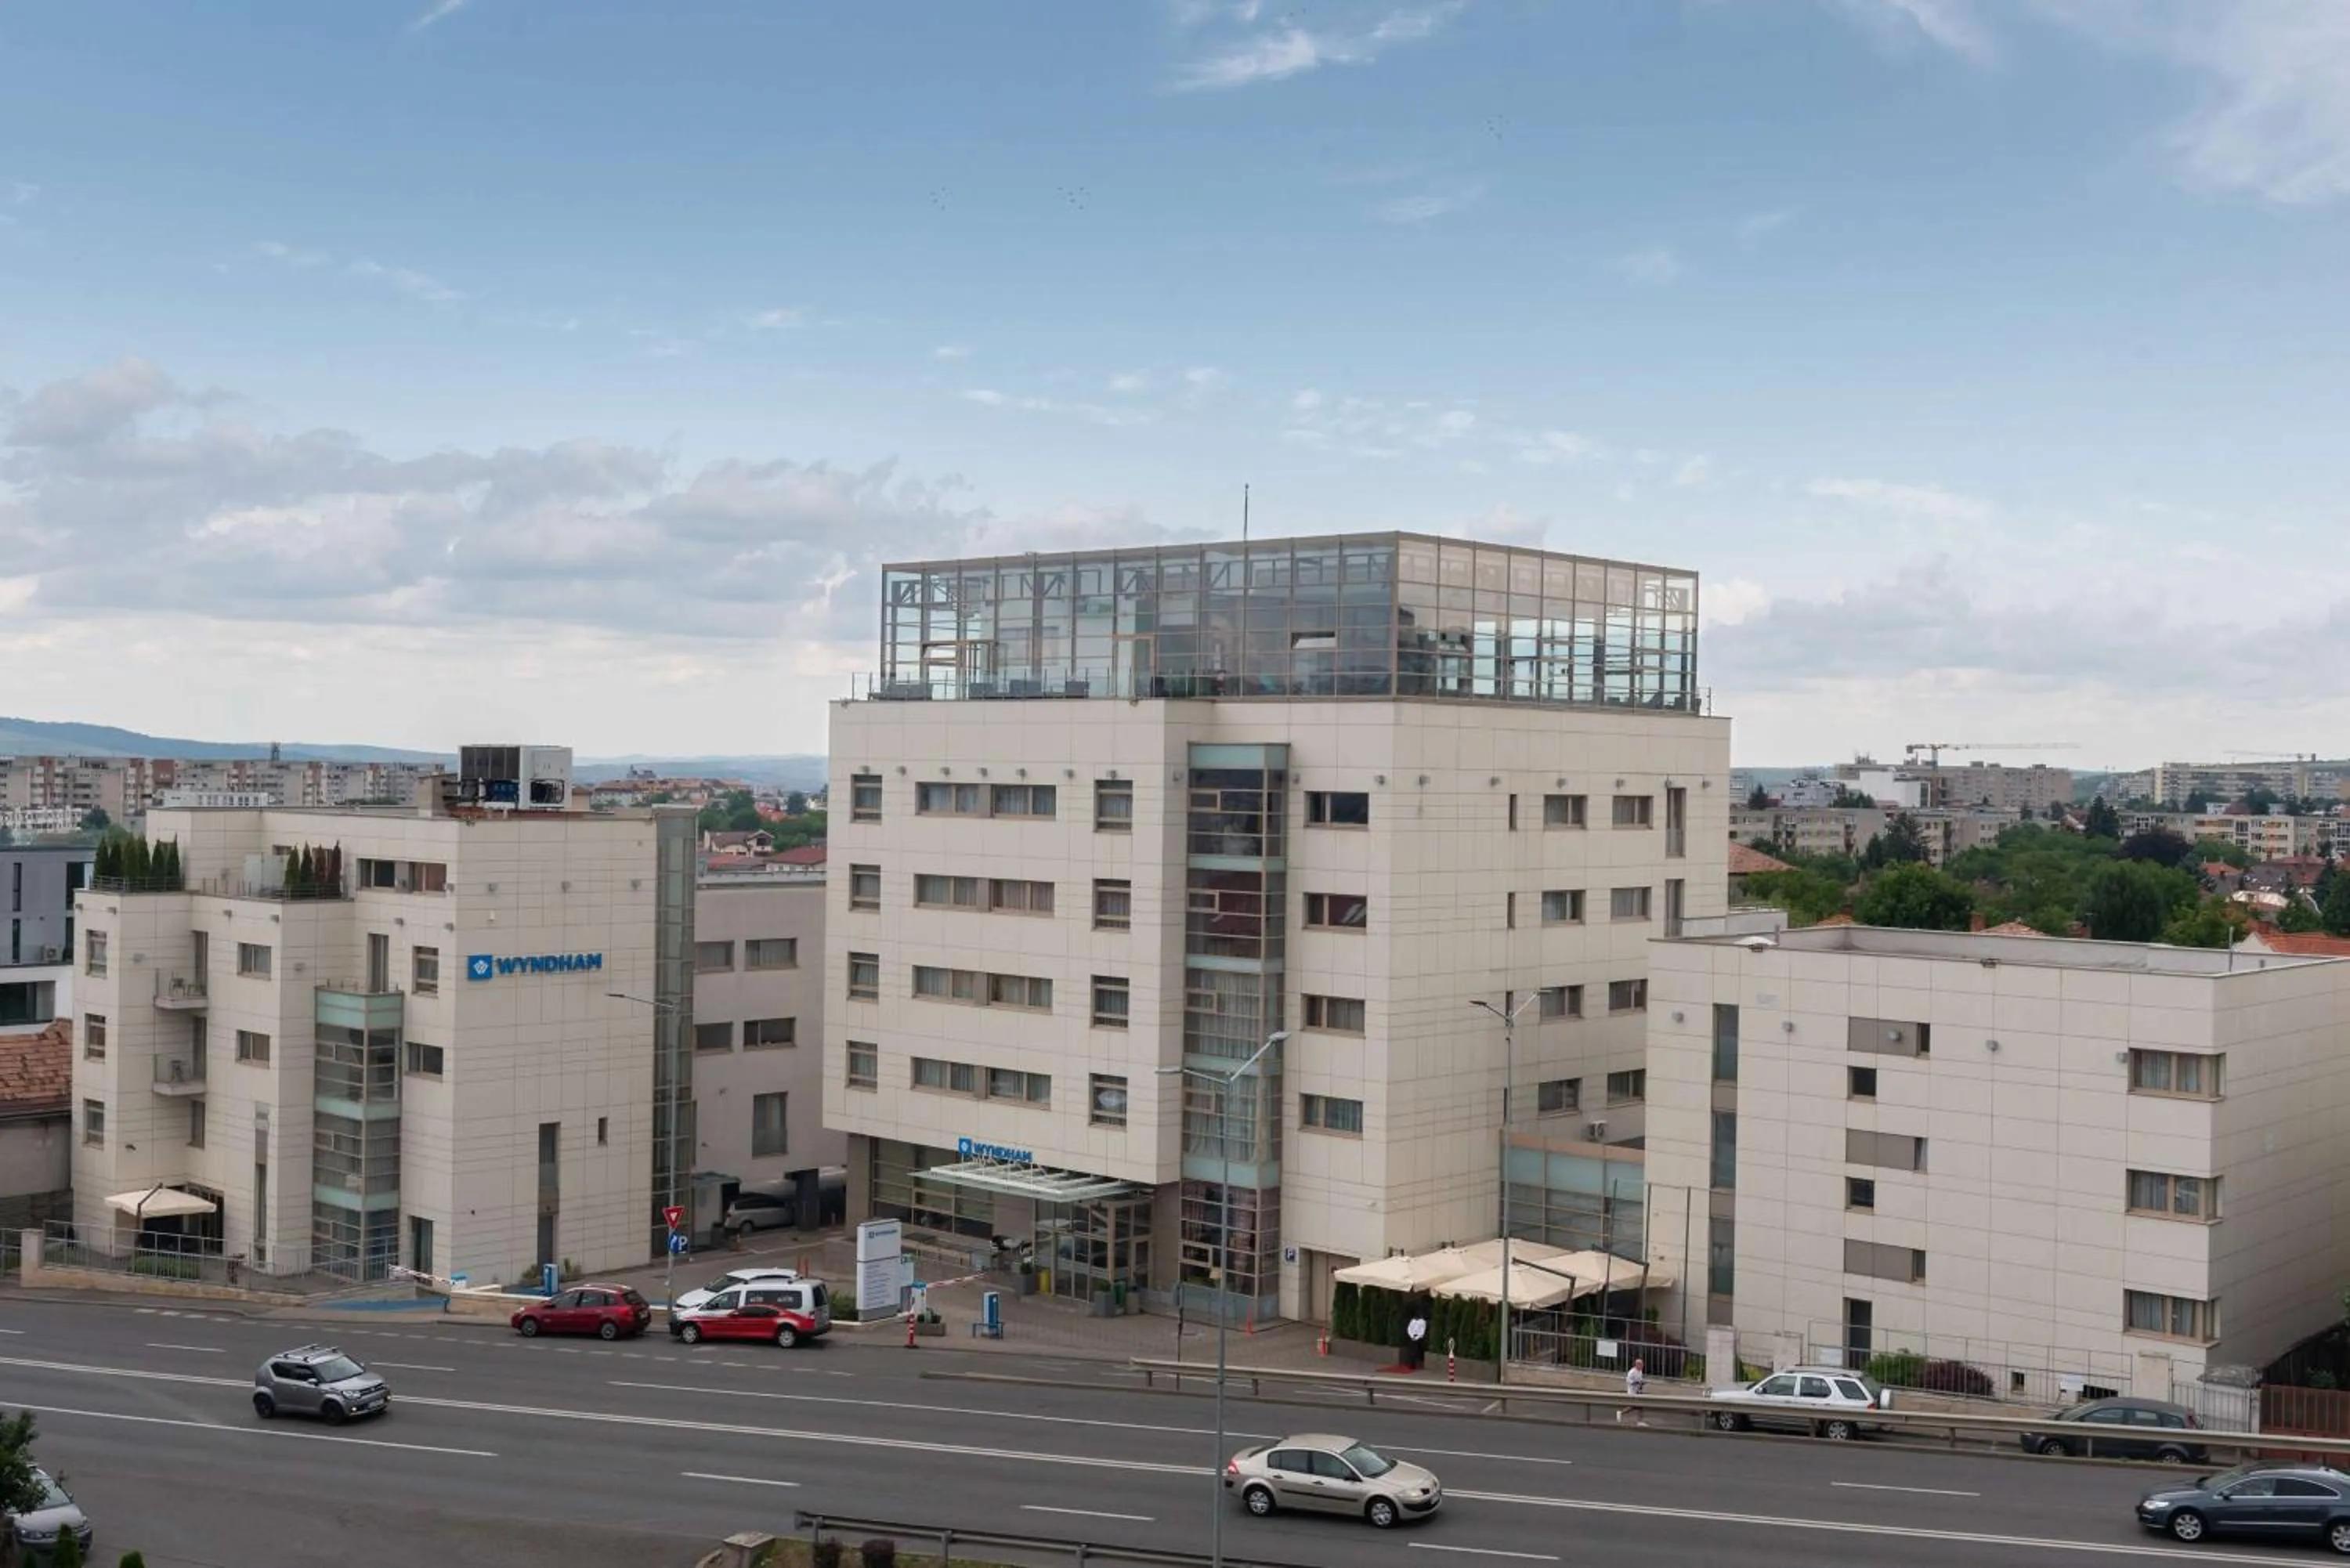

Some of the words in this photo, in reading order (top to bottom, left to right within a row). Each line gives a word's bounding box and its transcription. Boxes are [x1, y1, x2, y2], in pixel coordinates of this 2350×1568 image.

[496, 952, 602, 974] WYNDHAM
[974, 1143, 1032, 1162] WYNDHAM
[678, 1236, 688, 1251] P
